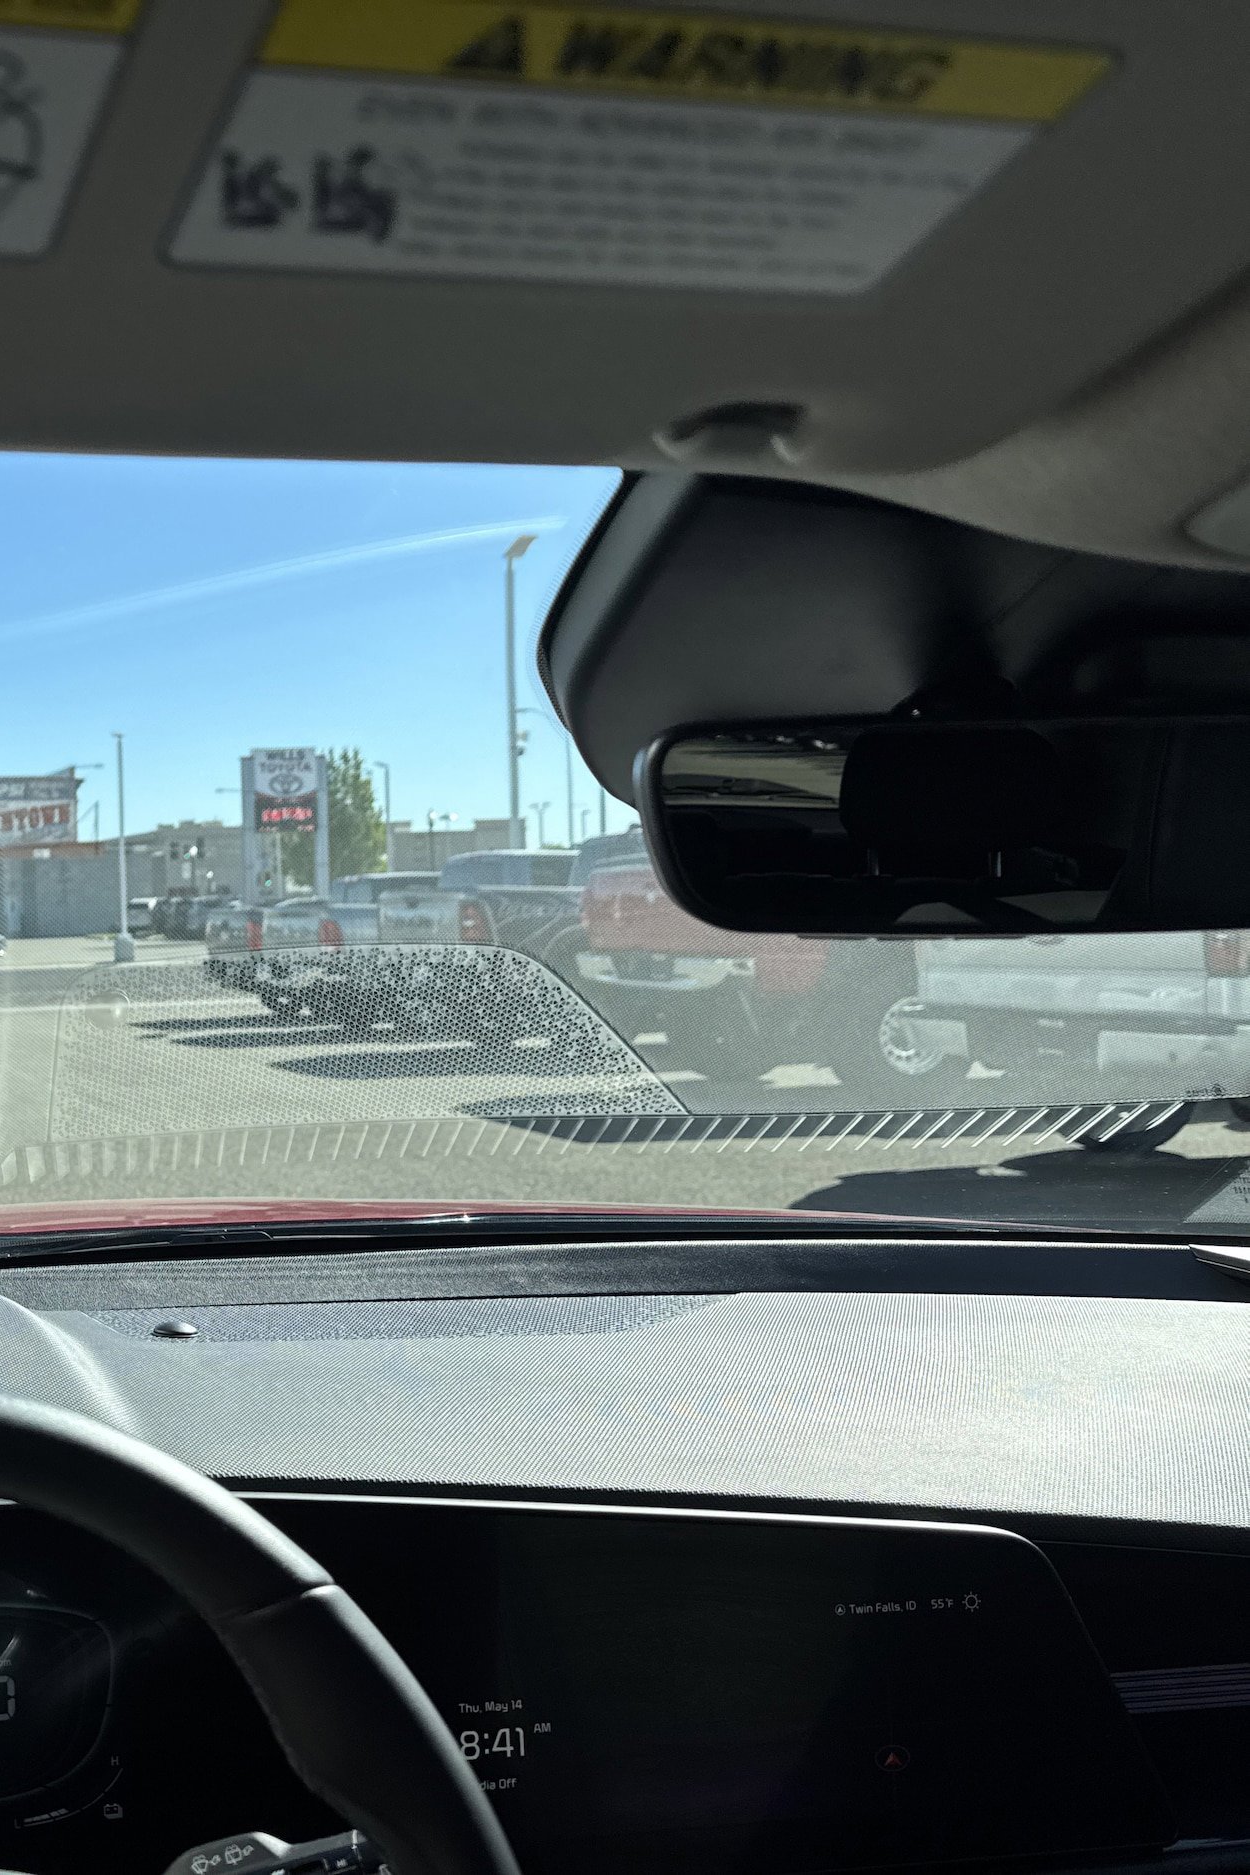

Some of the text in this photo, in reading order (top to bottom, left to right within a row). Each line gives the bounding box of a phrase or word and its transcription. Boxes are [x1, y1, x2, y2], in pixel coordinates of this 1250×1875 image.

[557, 20, 952, 101] WARNING
[265, 750, 305, 760] WILLS
[259, 761, 312, 773] TOYOTA
[849, 1601, 917, 1615] Twin Falls, ID
[485, 1701, 508, 1712] May
[511, 1700, 523, 1710] 14
[460, 1723, 551, 1761] 8:41 AM
[111, 1756, 119, 1766] H
[499, 1778, 517, 1789] Off
[14, 1819, 21, 1829] L
